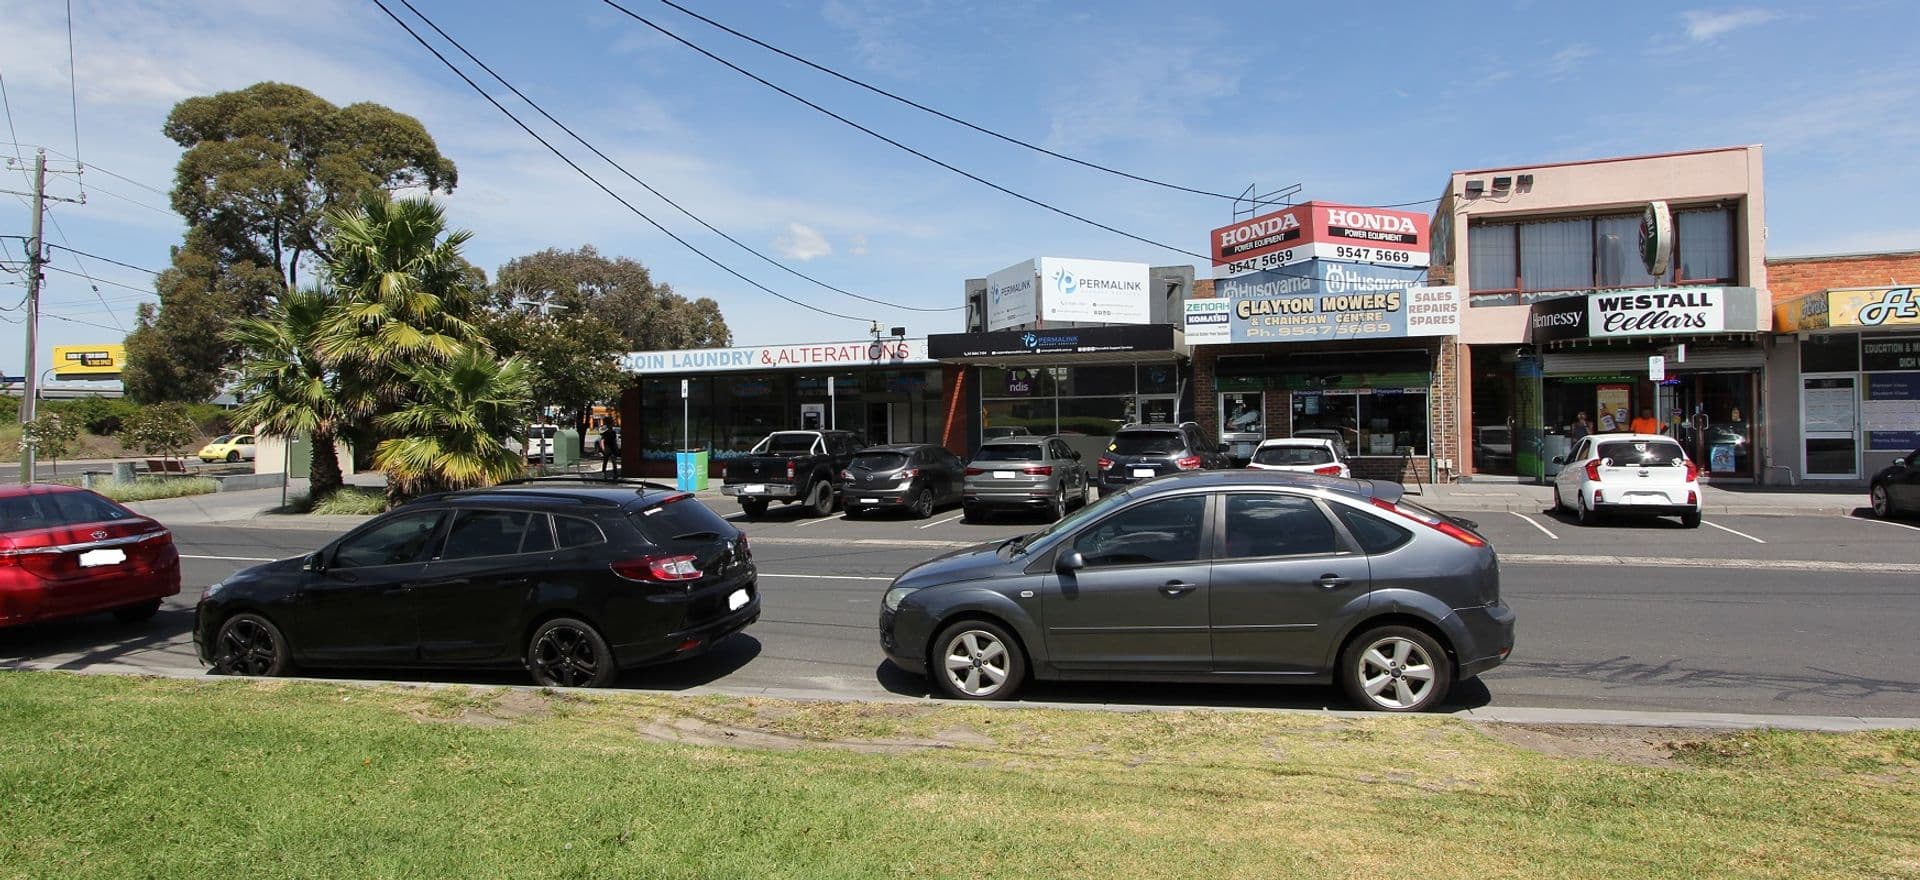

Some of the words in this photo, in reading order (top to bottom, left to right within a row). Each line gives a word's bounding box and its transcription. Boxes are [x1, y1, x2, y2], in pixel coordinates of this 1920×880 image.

[1327, 209, 1418, 234] HONDA
[1221, 213, 1300, 248] HONDA
[1344, 228, 1367, 238] POWER
[1367, 231, 1403, 242] EQUIPMENT
[1234, 240, 1254, 254] POWER
[1254, 234, 1285, 249] EQUIPMENT
[1228, 257, 1257, 274] 9547
[1261, 249, 1293, 269] 5669
[1336, 246, 1370, 259] 9547
[1376, 250, 1409, 263] 5669
[1001, 279, 1031, 297] PERMALINK
[1079, 278, 1142, 291] PERMALINK
[1239, 275, 1311, 297] Husqvarna
[1237, 297, 1314, 319] CLAYTON
[1321, 292, 1400, 313] MOWERS
[1415, 292, 1451, 302] SALES
[1598, 293, 1713, 312] WESTALL
[1409, 303, 1457, 314] REPAIRS
[1859, 288, 1920, 326] A
[1188, 313, 1227, 323] KOMATSU
[1251, 317, 1260, 326] &
[1264, 314, 1327, 326] CHAINSAW
[1335, 312, 1383, 324] CENTRE
[1410, 315, 1456, 326] SPARES
[1532, 309, 1583, 329] Hennessy
[1603, 310, 1706, 333] Cellars
[1247, 327, 1275, 337] Ph.
[1279, 325, 1330, 337] 9547
[1335, 323, 1391, 334] 5669
[1038, 336, 1079, 344] PERMALINK
[1864, 343, 1903, 353] EDUCATION
[1904, 343, 1912, 353] &
[624, 351, 665, 371] COIN
[671, 349, 754, 369] LAUNDRY
[761, 349, 772, 364] &
[778, 342, 909, 364] ALTERATIONS
[1009, 382, 1029, 392] ndis
